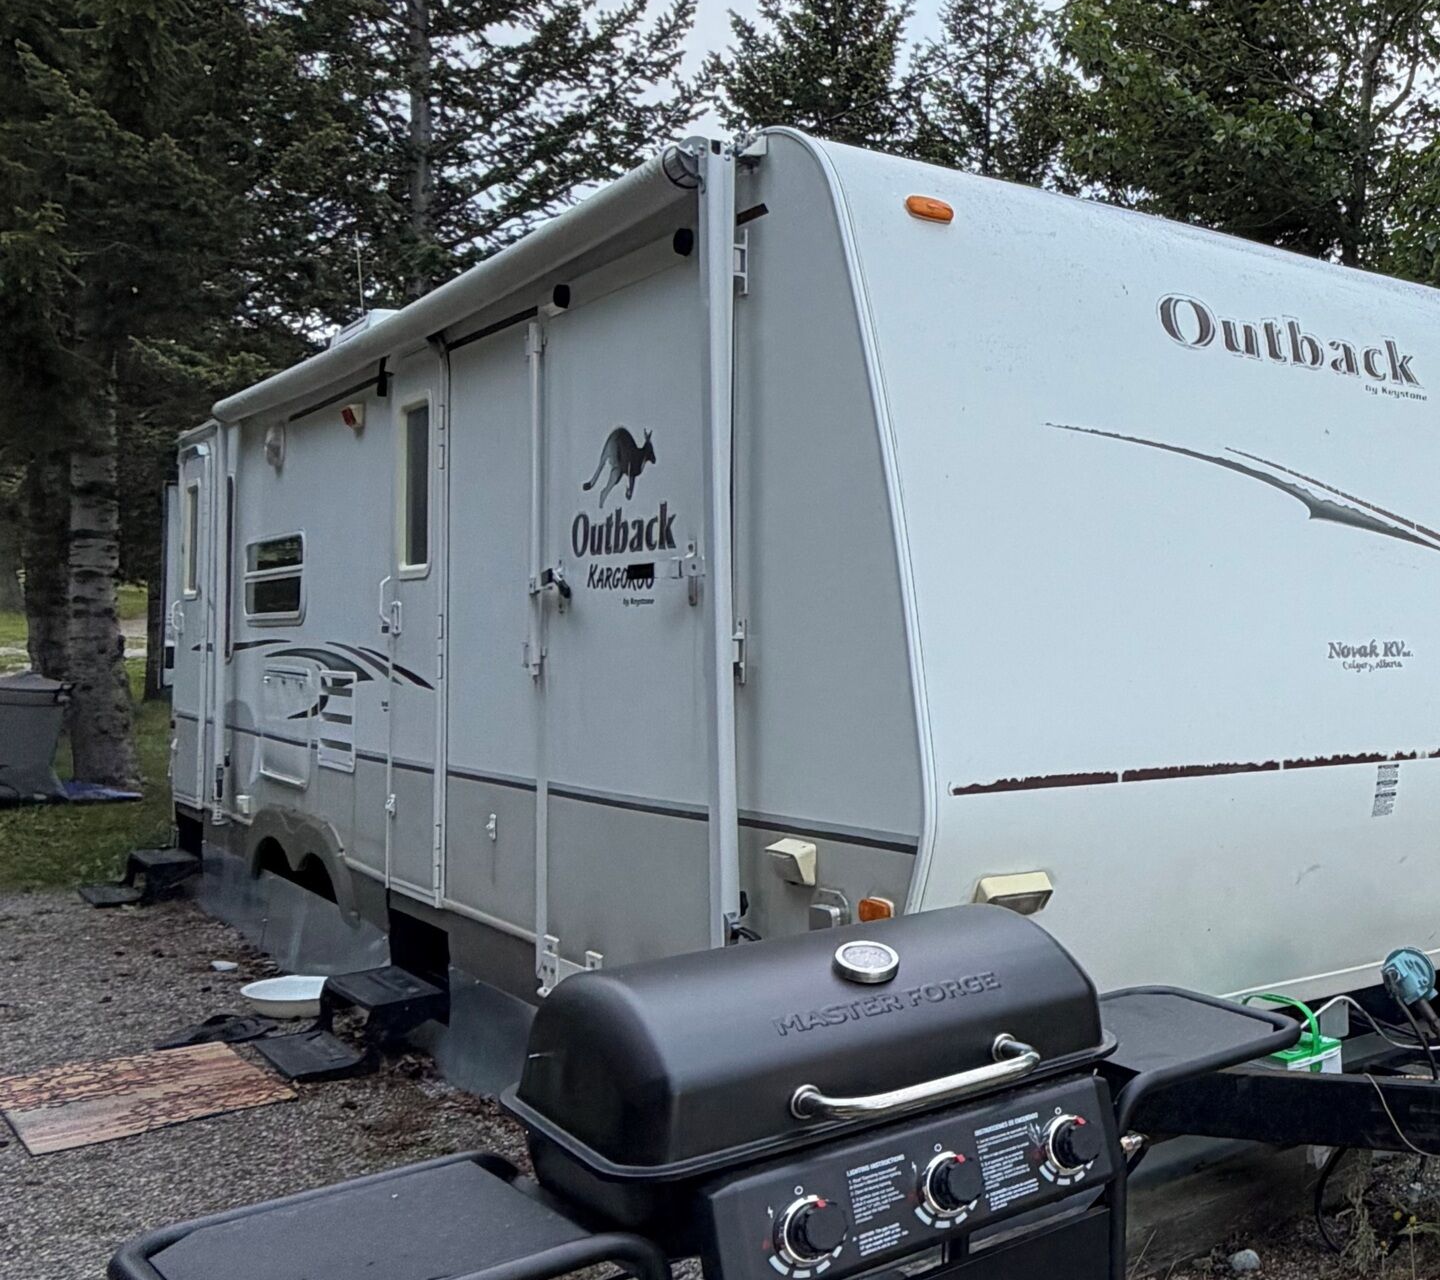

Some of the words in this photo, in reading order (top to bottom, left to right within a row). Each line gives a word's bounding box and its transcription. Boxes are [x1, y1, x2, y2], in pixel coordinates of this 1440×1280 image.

[1156, 293, 1424, 388] Outback
[1365, 383, 1378, 395] by
[1381, 385, 1428, 401] Keystone
[572, 501, 677, 558] Outback
[1327, 638, 1380, 659] Novak
[1382, 640, 1405, 657] RV
[774, 992, 904, 1037] MASTER
[903, 971, 1002, 1008] FORGE
